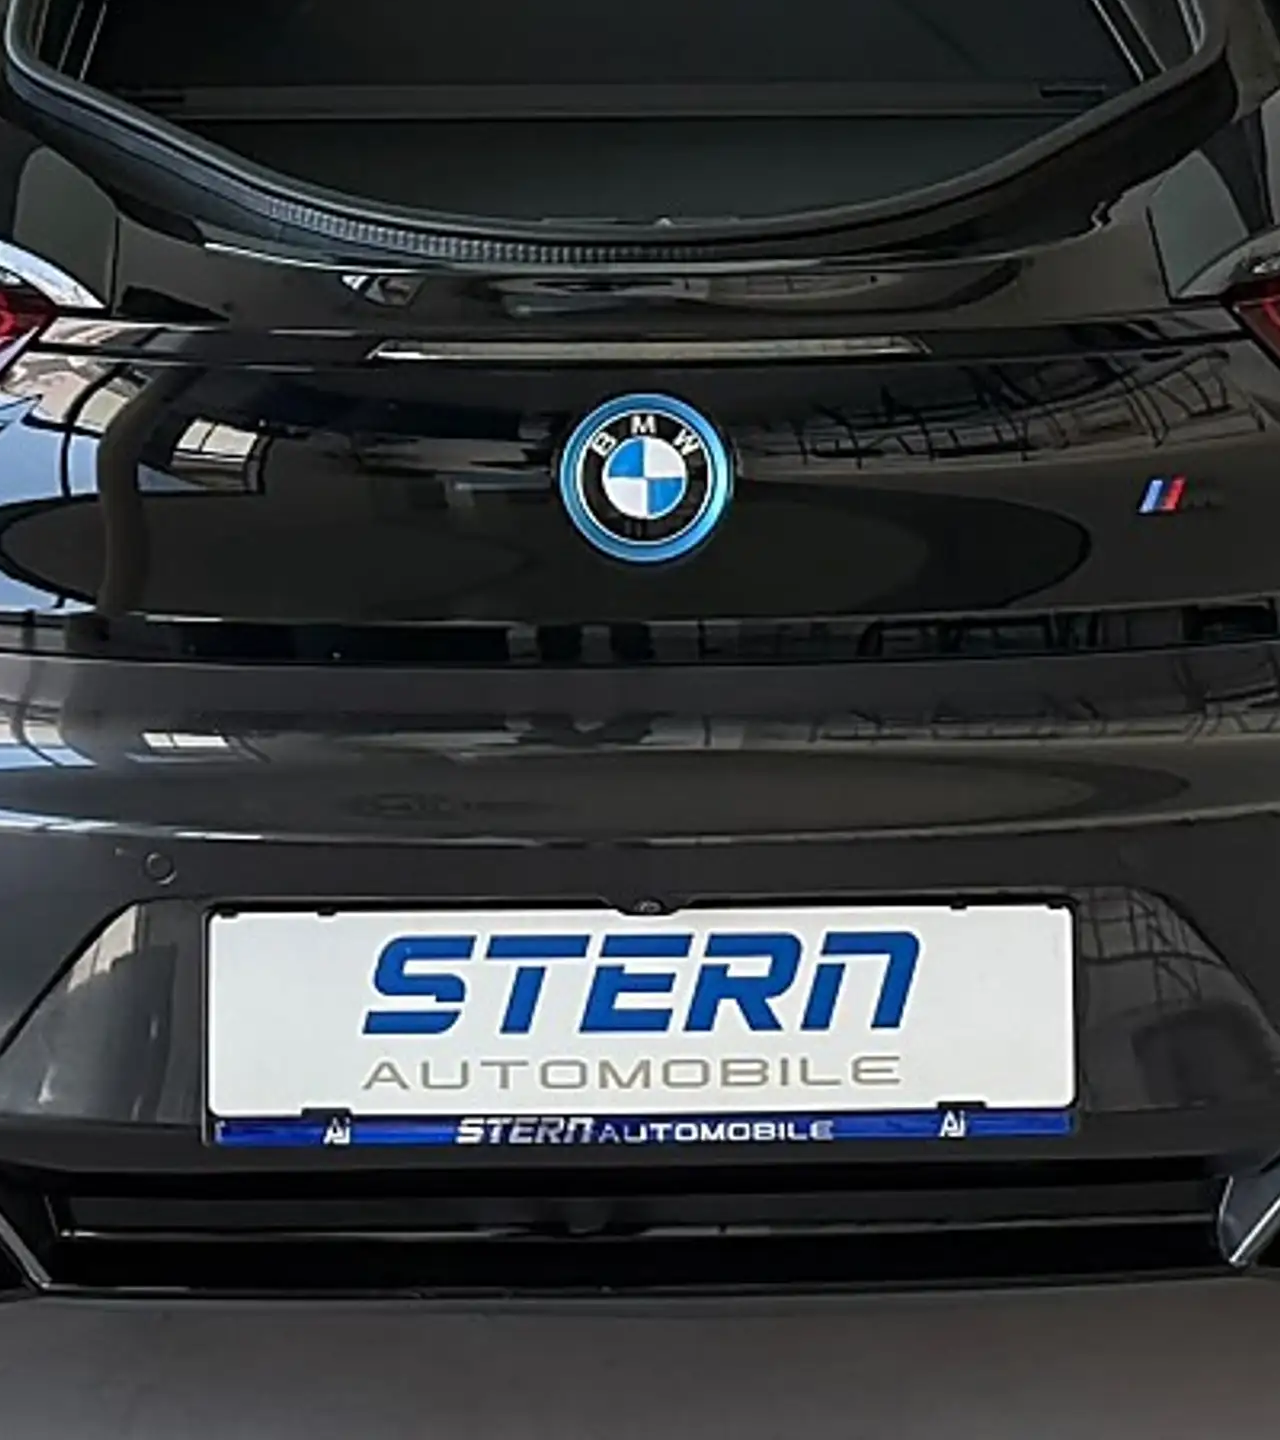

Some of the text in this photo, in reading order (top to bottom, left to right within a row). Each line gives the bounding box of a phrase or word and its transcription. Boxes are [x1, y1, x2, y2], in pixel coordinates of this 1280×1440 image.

[590, 414, 701, 458] BMW
[361, 930, 922, 1035] STERN
[361, 1055, 902, 1091] AUTOMOBILE
[455, 1116, 835, 1144] STERN AUTOMOBILE
